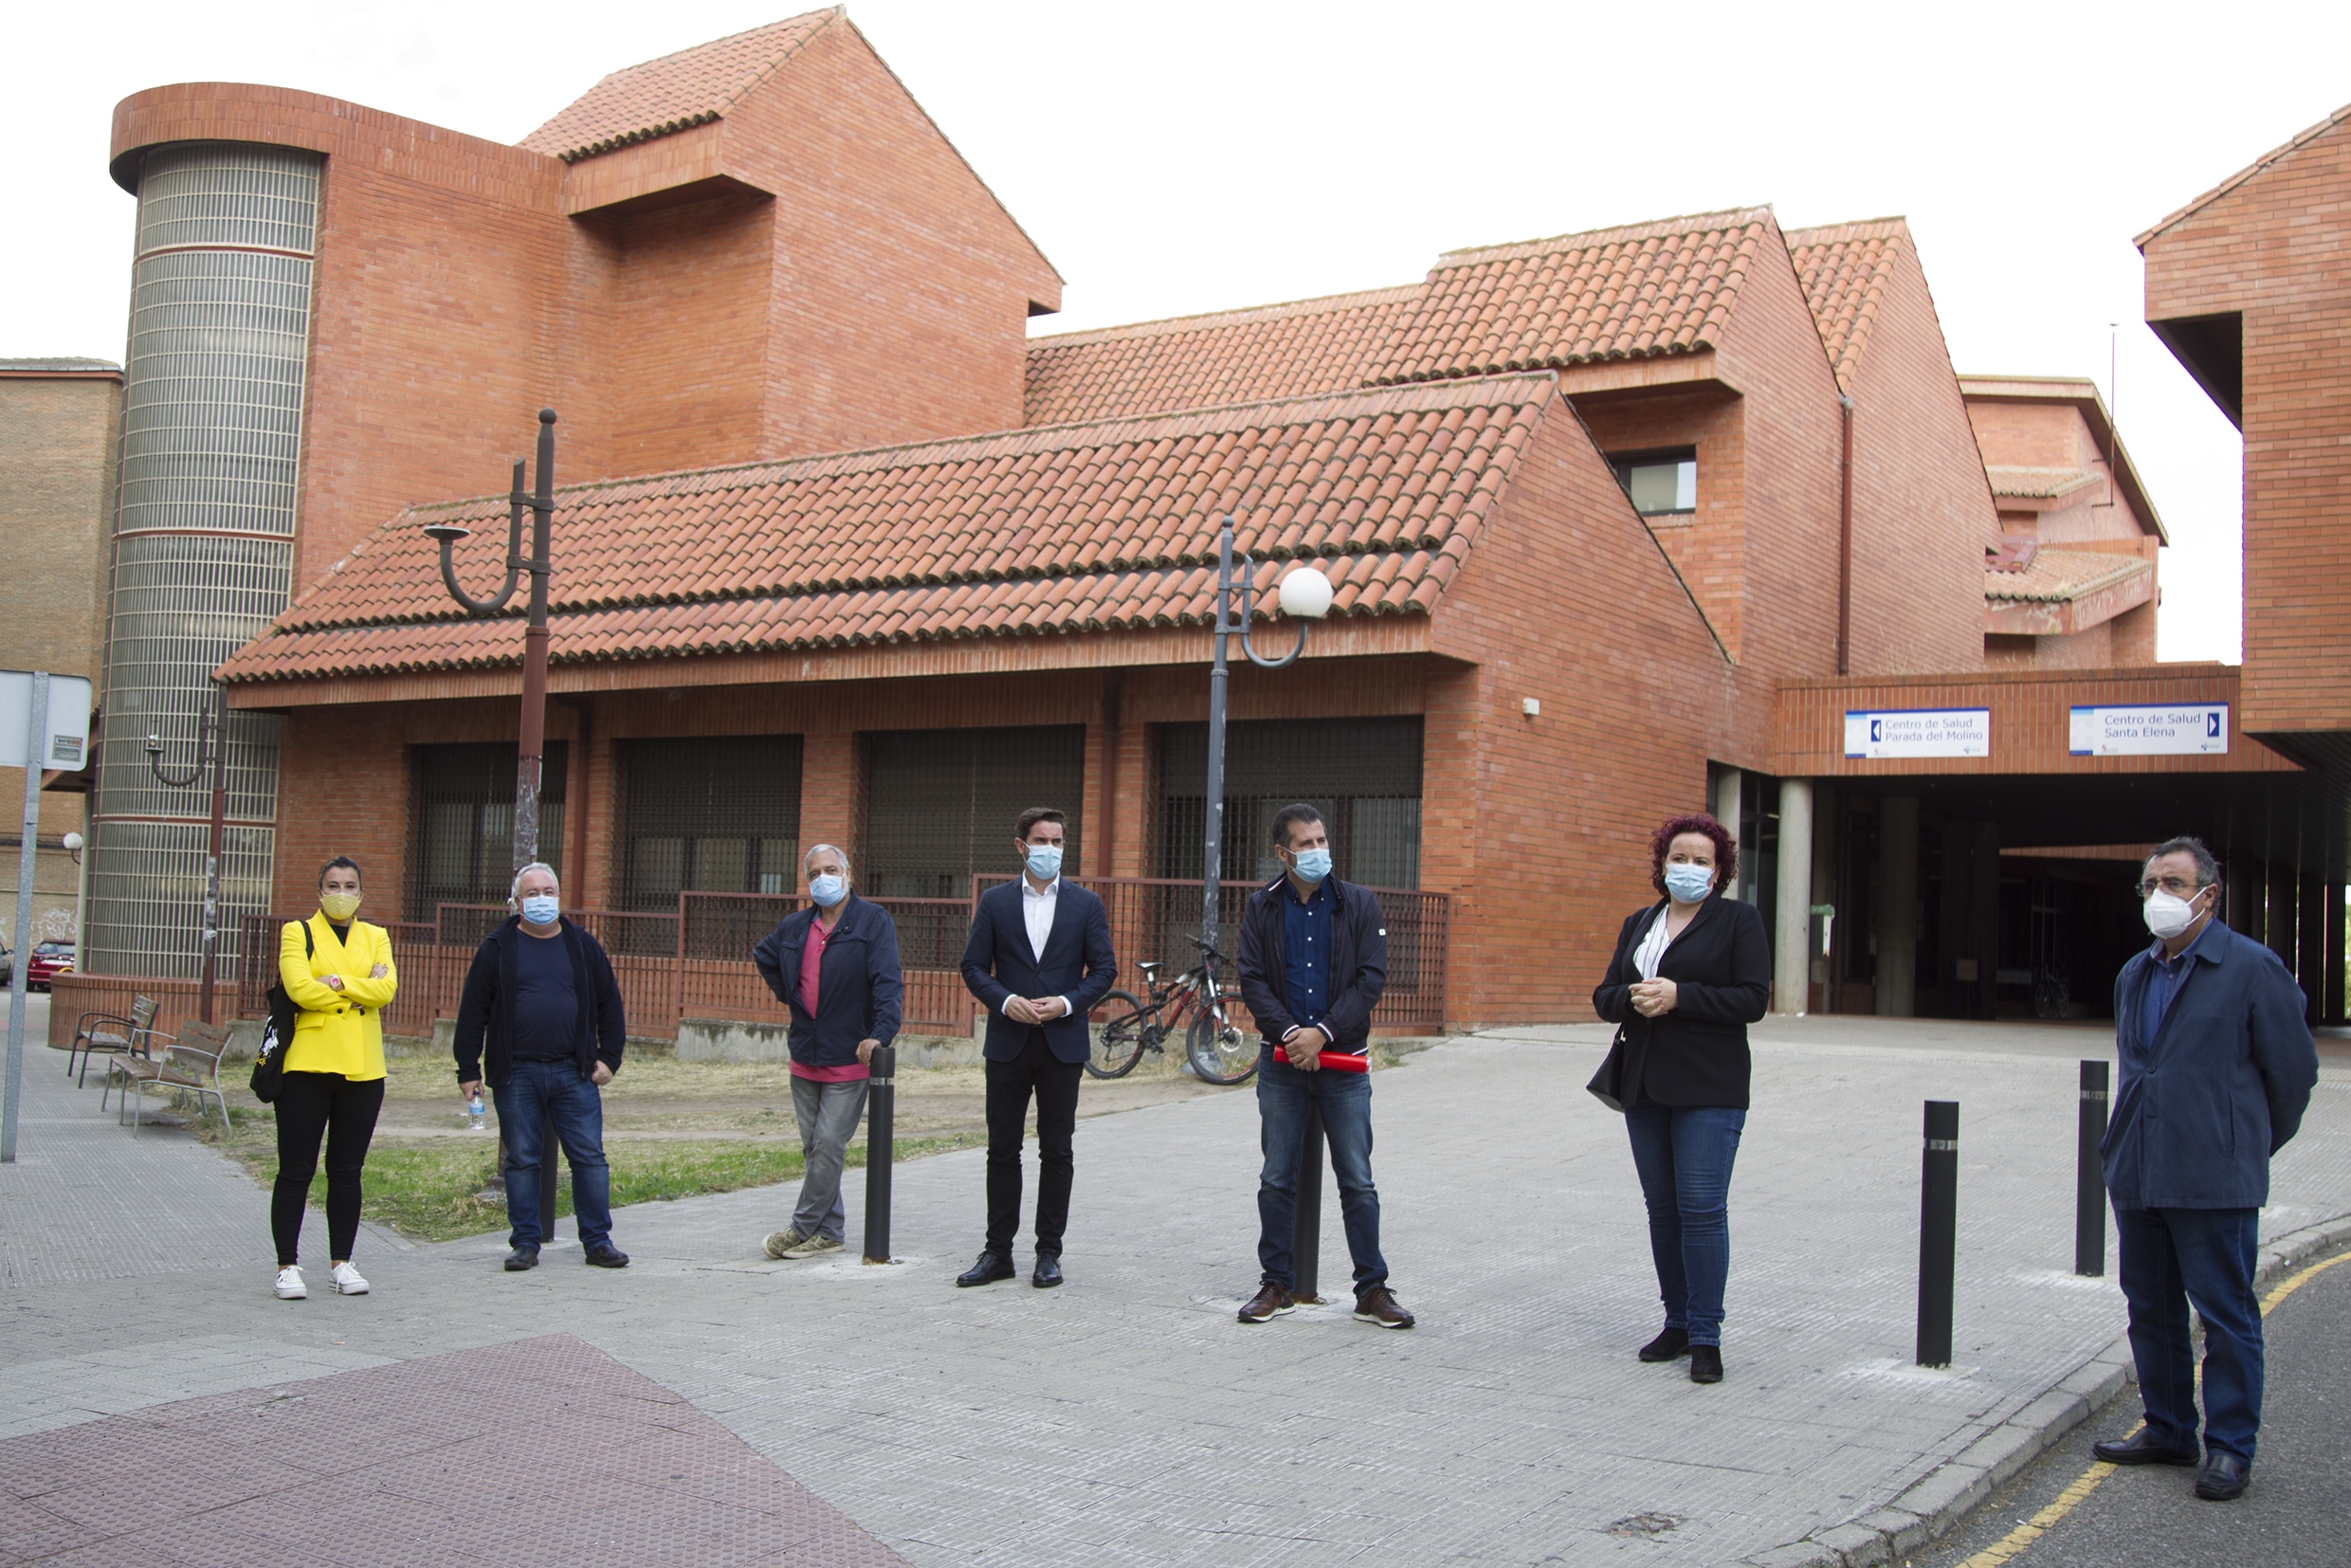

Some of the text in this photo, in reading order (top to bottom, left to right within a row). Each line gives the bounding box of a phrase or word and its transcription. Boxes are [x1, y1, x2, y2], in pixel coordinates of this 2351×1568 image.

[1886, 718, 1973, 729] Centro de Salud
[2105, 713, 2201, 725] Centro de Salud
[1886, 731, 1983, 741] Parada del Molino
[2105, 727, 2175, 738] Santa Elena
